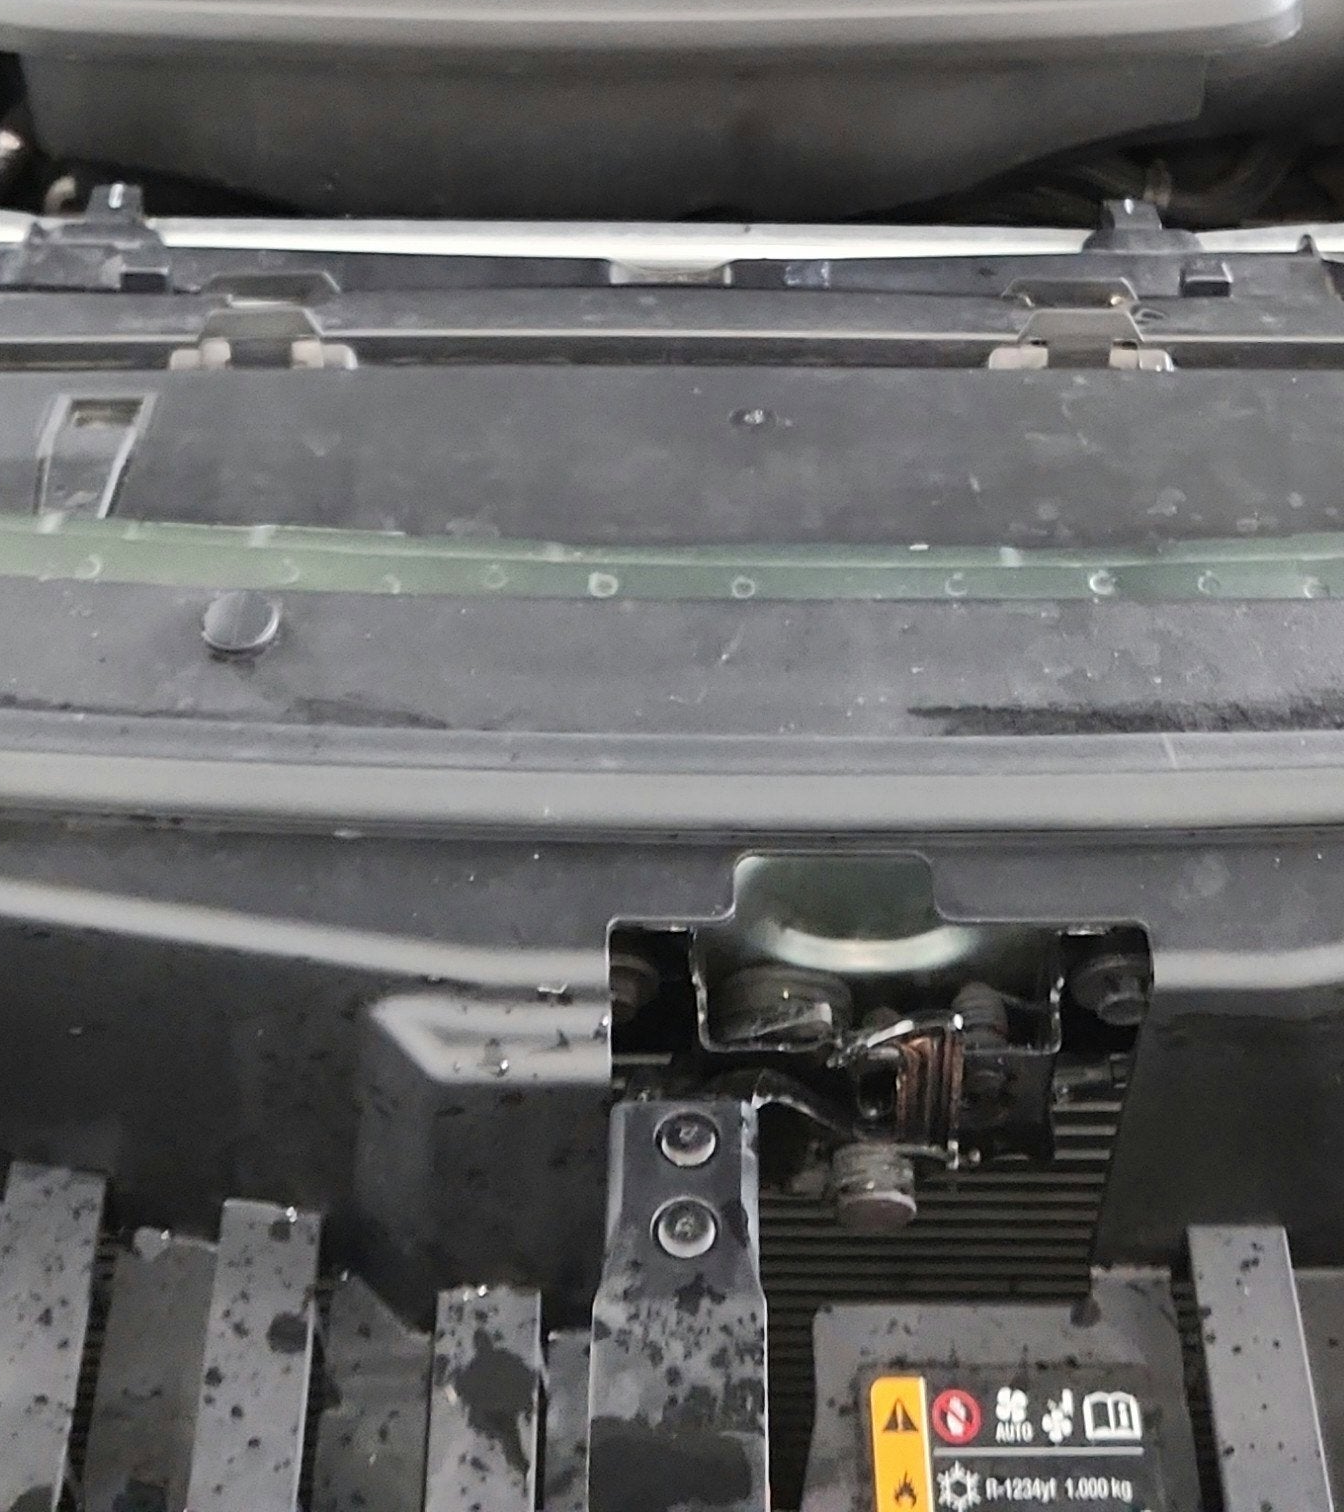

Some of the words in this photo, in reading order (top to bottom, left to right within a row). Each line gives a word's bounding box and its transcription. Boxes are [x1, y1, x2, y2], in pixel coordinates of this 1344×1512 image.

[995, 1420, 1034, 1444] AUTO
[985, 1476, 1057, 1504] R-1234yf
[1064, 1476, 1110, 1501] 1.000
[1110, 1476, 1134, 1504] kg
